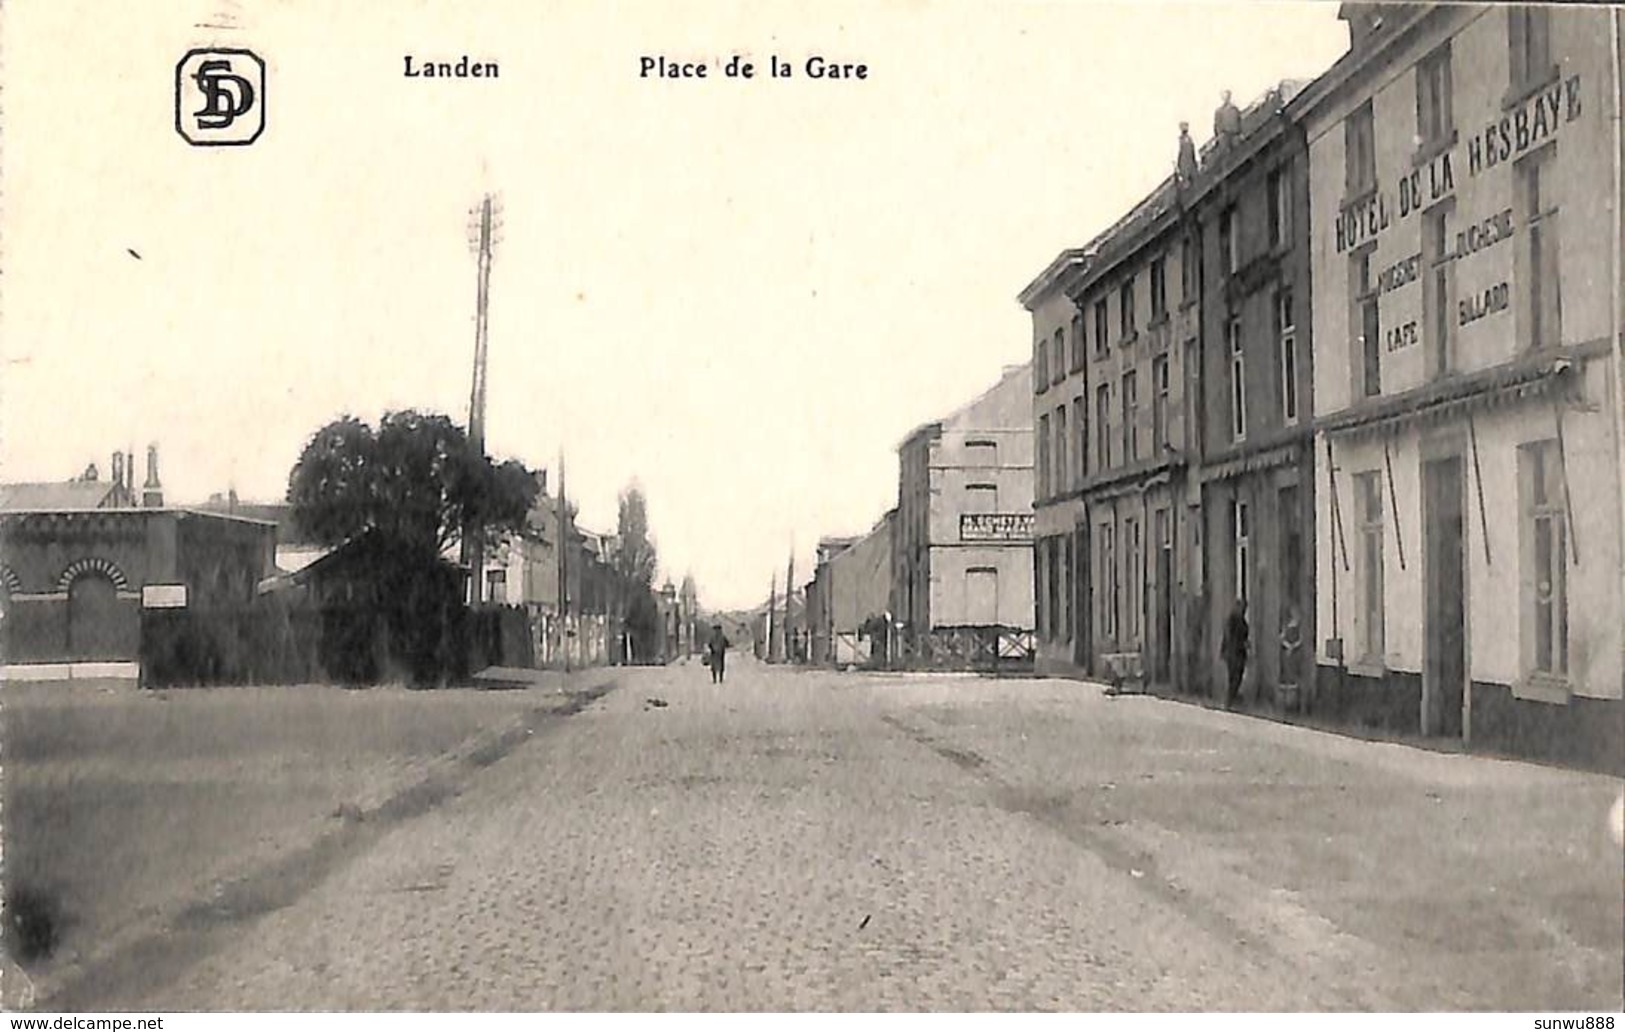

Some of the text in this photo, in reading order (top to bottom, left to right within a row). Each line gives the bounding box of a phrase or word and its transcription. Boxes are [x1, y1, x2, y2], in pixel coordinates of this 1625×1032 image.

[1336, 74, 1582, 253] HOTEL DE LA HESBAYE
[1459, 282, 1508, 326] BILLARD
